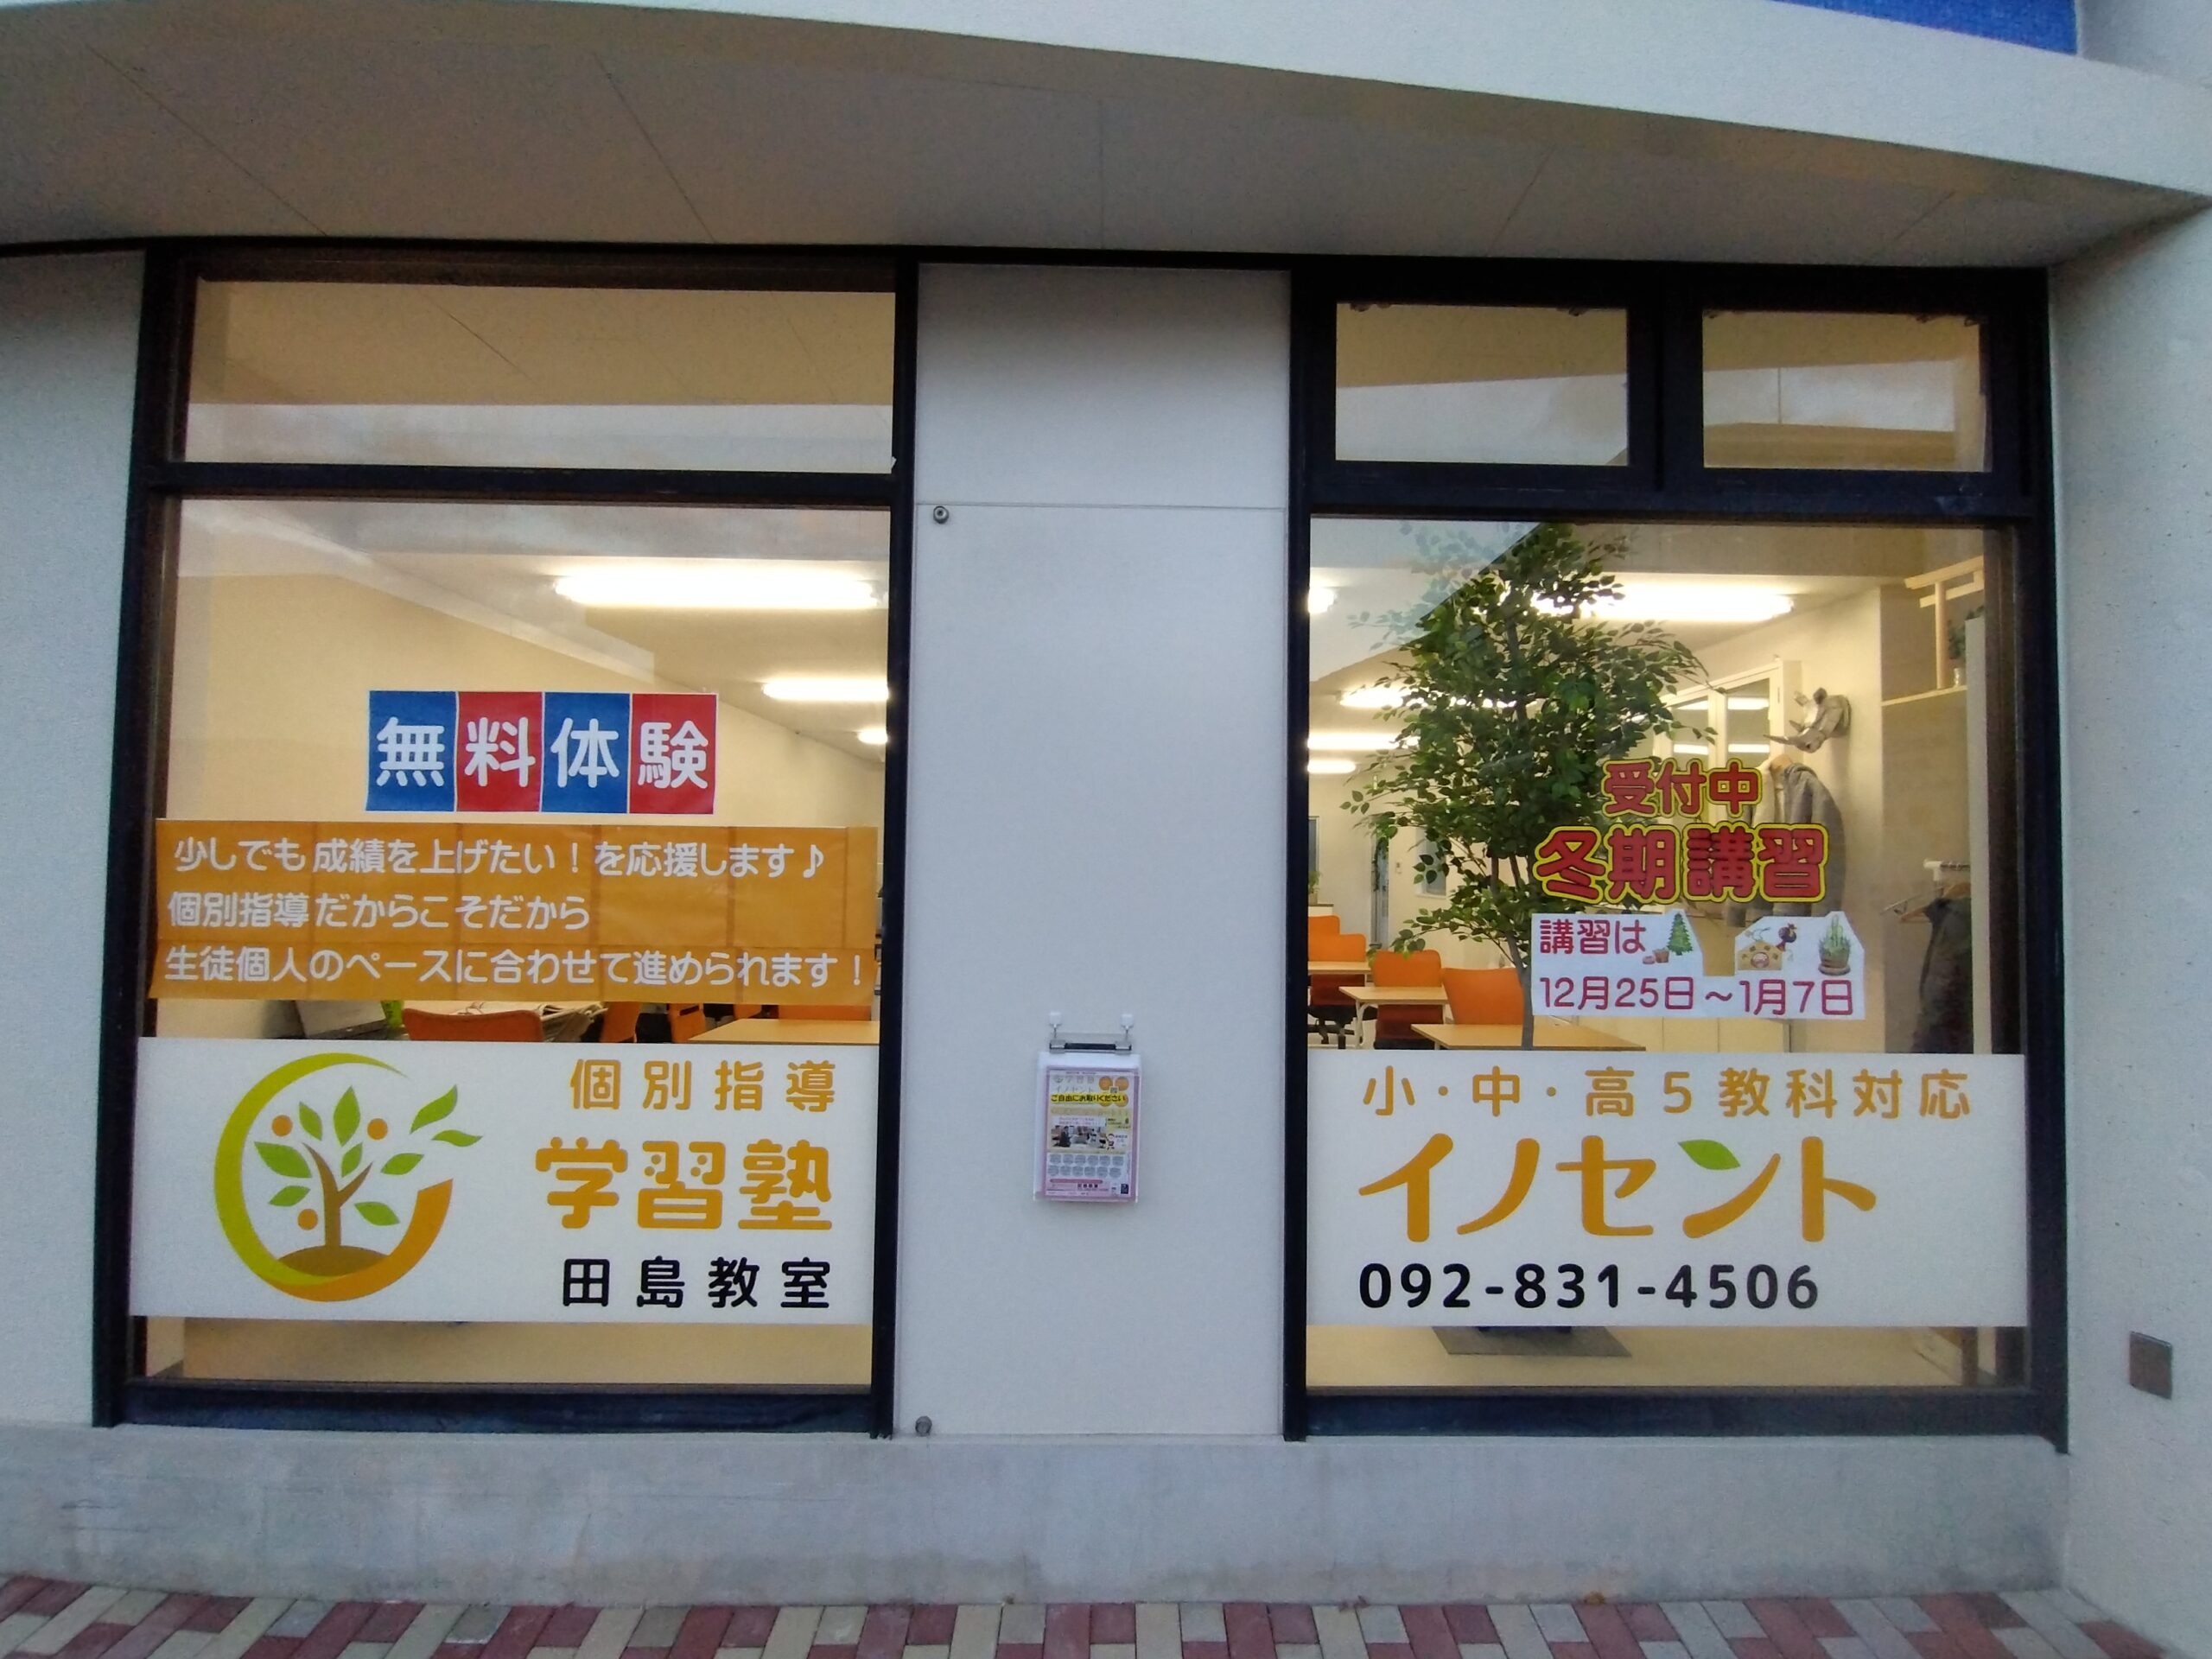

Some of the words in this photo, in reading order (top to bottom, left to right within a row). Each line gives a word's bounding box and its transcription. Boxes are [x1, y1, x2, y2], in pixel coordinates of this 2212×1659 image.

[376, 716, 709, 790] 無料体験
[1602, 758, 1763, 817] 受付中
[1533, 821, 1829, 904] 冬期講習
[168, 891, 589, 930] 個別指導だからこそだから
[1540, 919, 1645, 956] 講習は
[569, 1059, 836, 1112] 個別指導
[536, 1136, 833, 1230] 学習塾
[1358, 1132, 1878, 1243] イノセント
[562, 1256, 831, 1308] 田島教室
[1359, 1262, 1819, 1310] 092-831-4506
